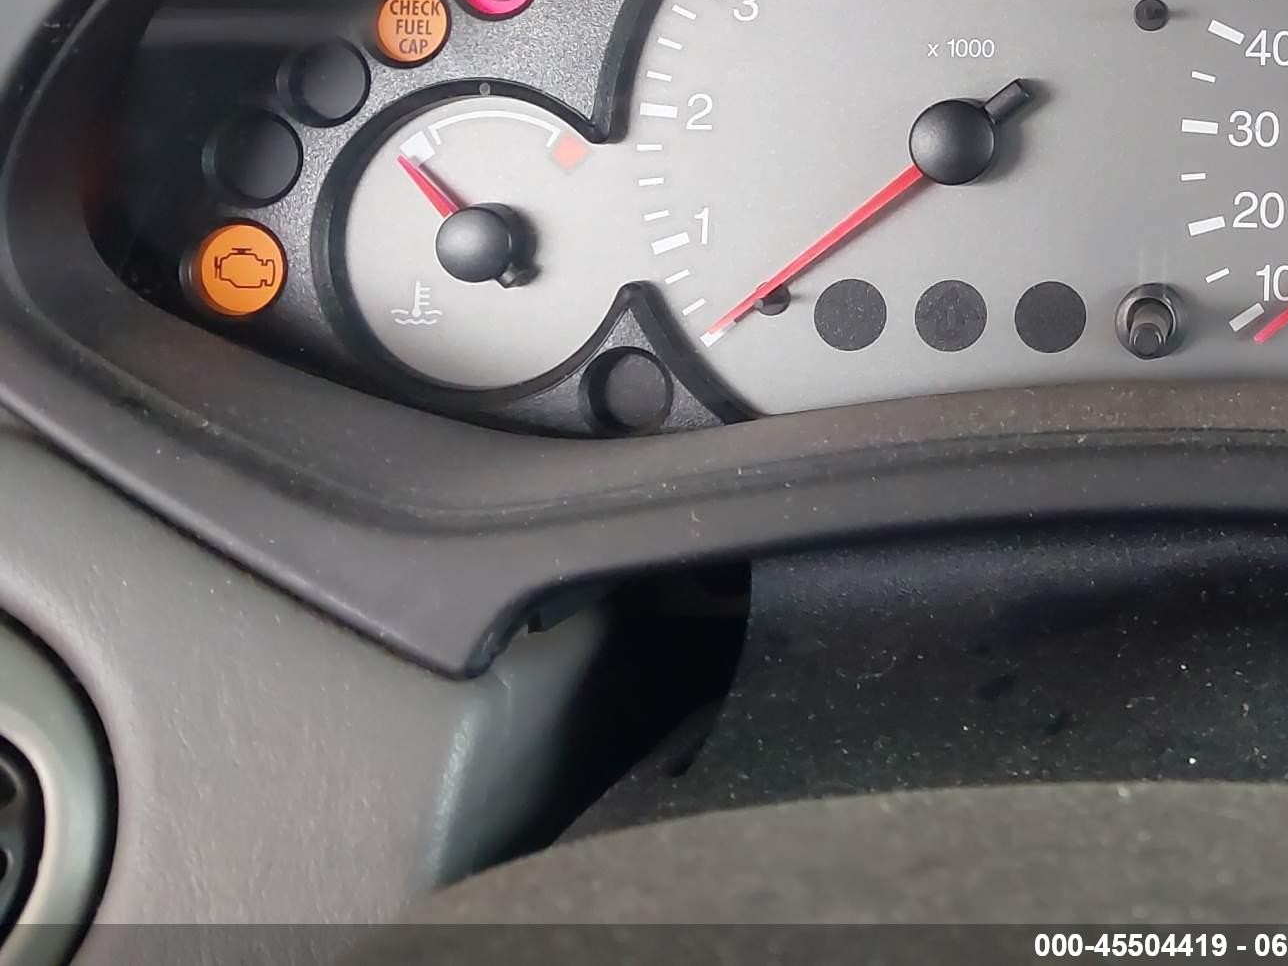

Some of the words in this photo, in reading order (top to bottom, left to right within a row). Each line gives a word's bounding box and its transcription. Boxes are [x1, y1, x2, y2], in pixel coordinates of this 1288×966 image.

[390, 0, 440, 17] CHECK
[396, 19, 433, 35] FUEL
[398, 39, 429, 55] CAP
[947, 39, 995, 58] 1000
[686, 94, 713, 130] 2
[1228, 111, 1279, 146] 30
[1233, 193, 1285, 228] 20
[695, 207, 710, 244] 1
